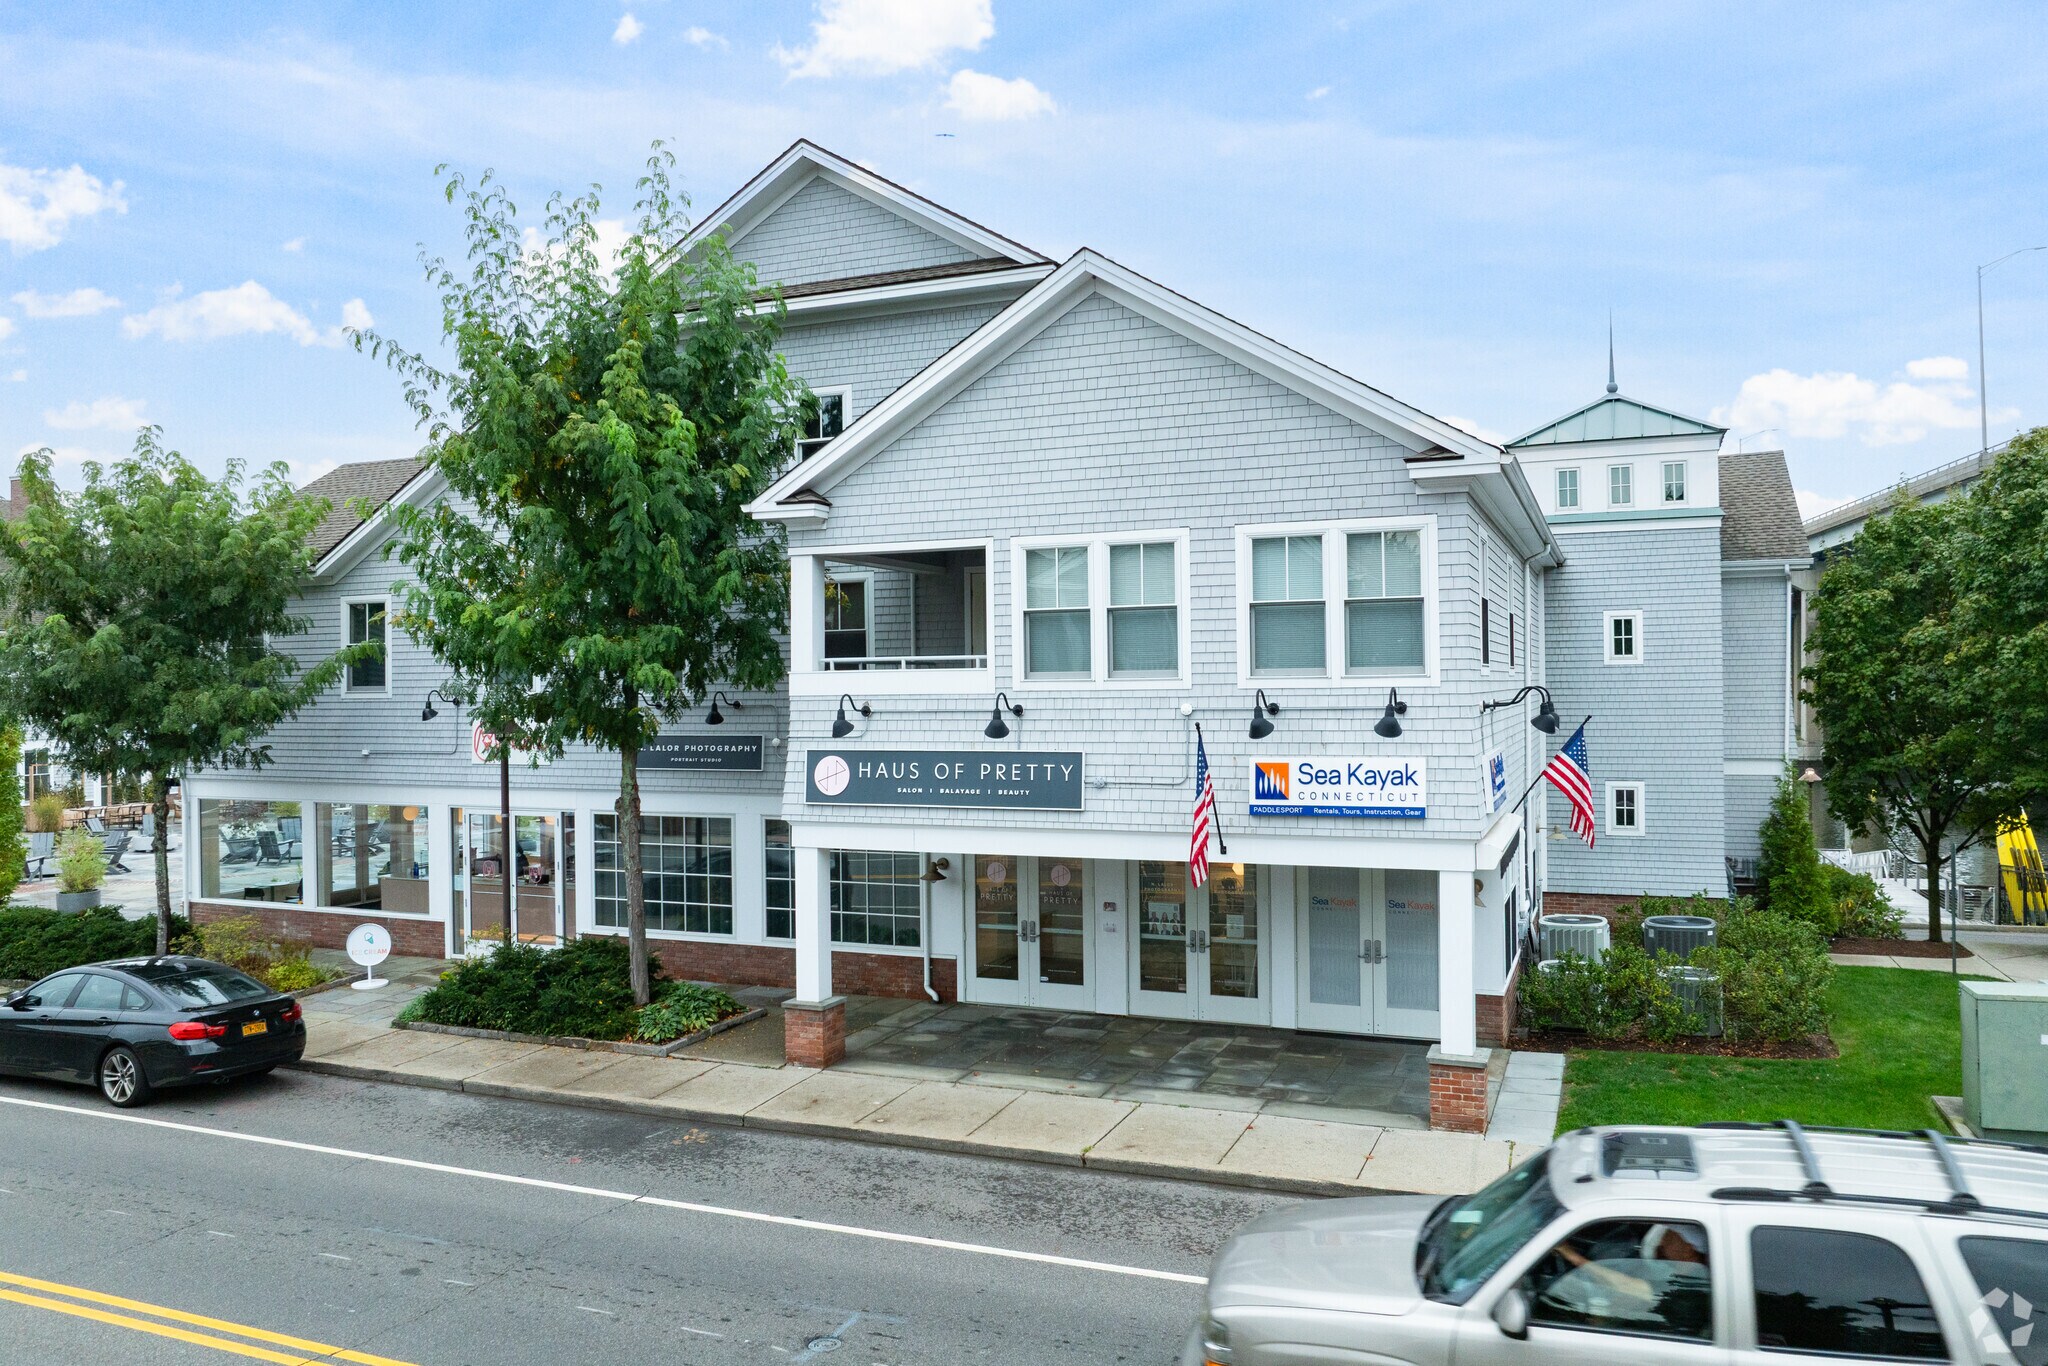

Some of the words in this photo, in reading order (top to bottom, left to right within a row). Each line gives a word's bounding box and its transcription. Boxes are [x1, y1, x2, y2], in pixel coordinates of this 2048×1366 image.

[858, 762, 920, 779] HAUS
[934, 762, 965, 780] OF
[980, 763, 1074, 782] PRETTY
[1298, 763, 1341, 785] Sea
[1348, 763, 1419, 791] Kayak
[1298, 791, 1419, 802] CONNECTICUT
[1253, 806, 1303, 814] PADDLESPORT
[1313, 807, 1341, 815] Rentals,
[1363, 808, 1403, 816] Instruction,
[980, 892, 1014, 901] PRETTY
[1043, 896, 1079, 905] PRETTY
[1311, 896, 1329, 905] Sea
[1330, 897, 1357, 908] Kayak
[1388, 900, 1406, 909] Sea
[1407, 900, 1435, 911] Kayak
